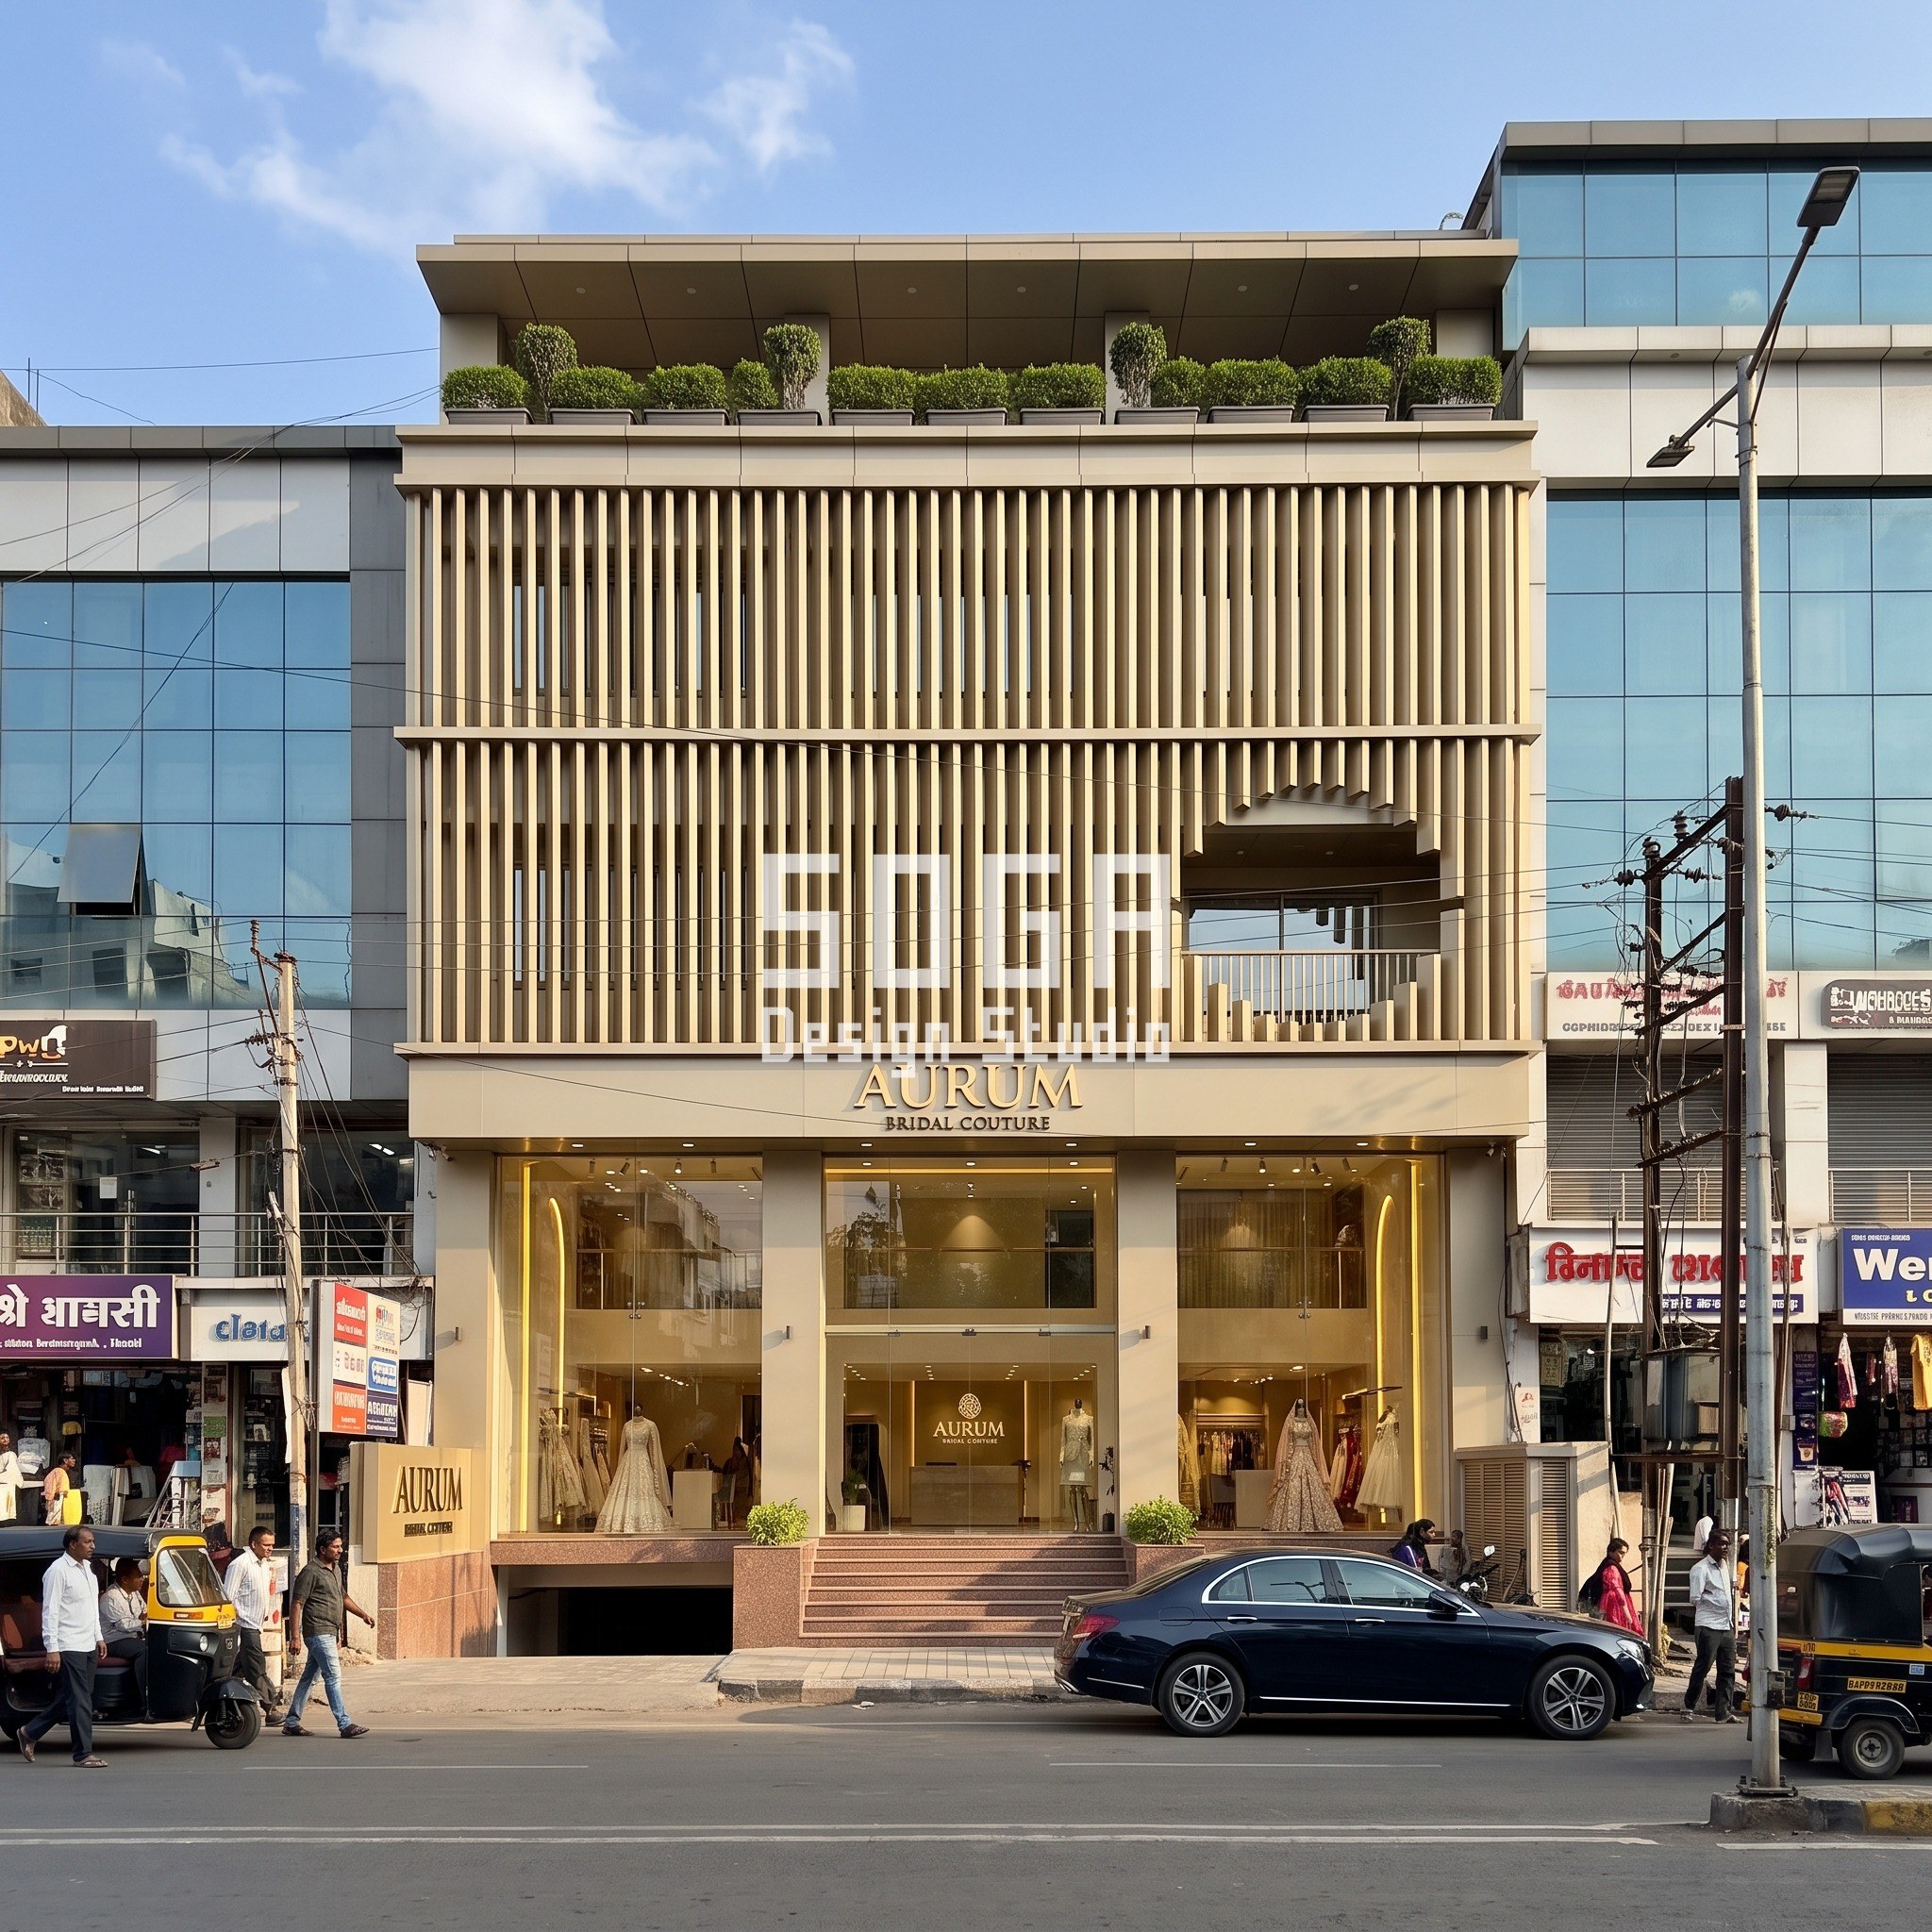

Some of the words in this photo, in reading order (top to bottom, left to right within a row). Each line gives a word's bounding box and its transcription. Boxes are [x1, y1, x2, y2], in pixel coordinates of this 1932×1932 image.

[854, 1063, 1084, 1109] AURUM
[886, 1116, 953, 1130] BRIDAL
[959, 1116, 1050, 1130] COUTURE
[932, 1421, 1006, 1437] AURUM
[391, 1465, 463, 1514] AURUM
